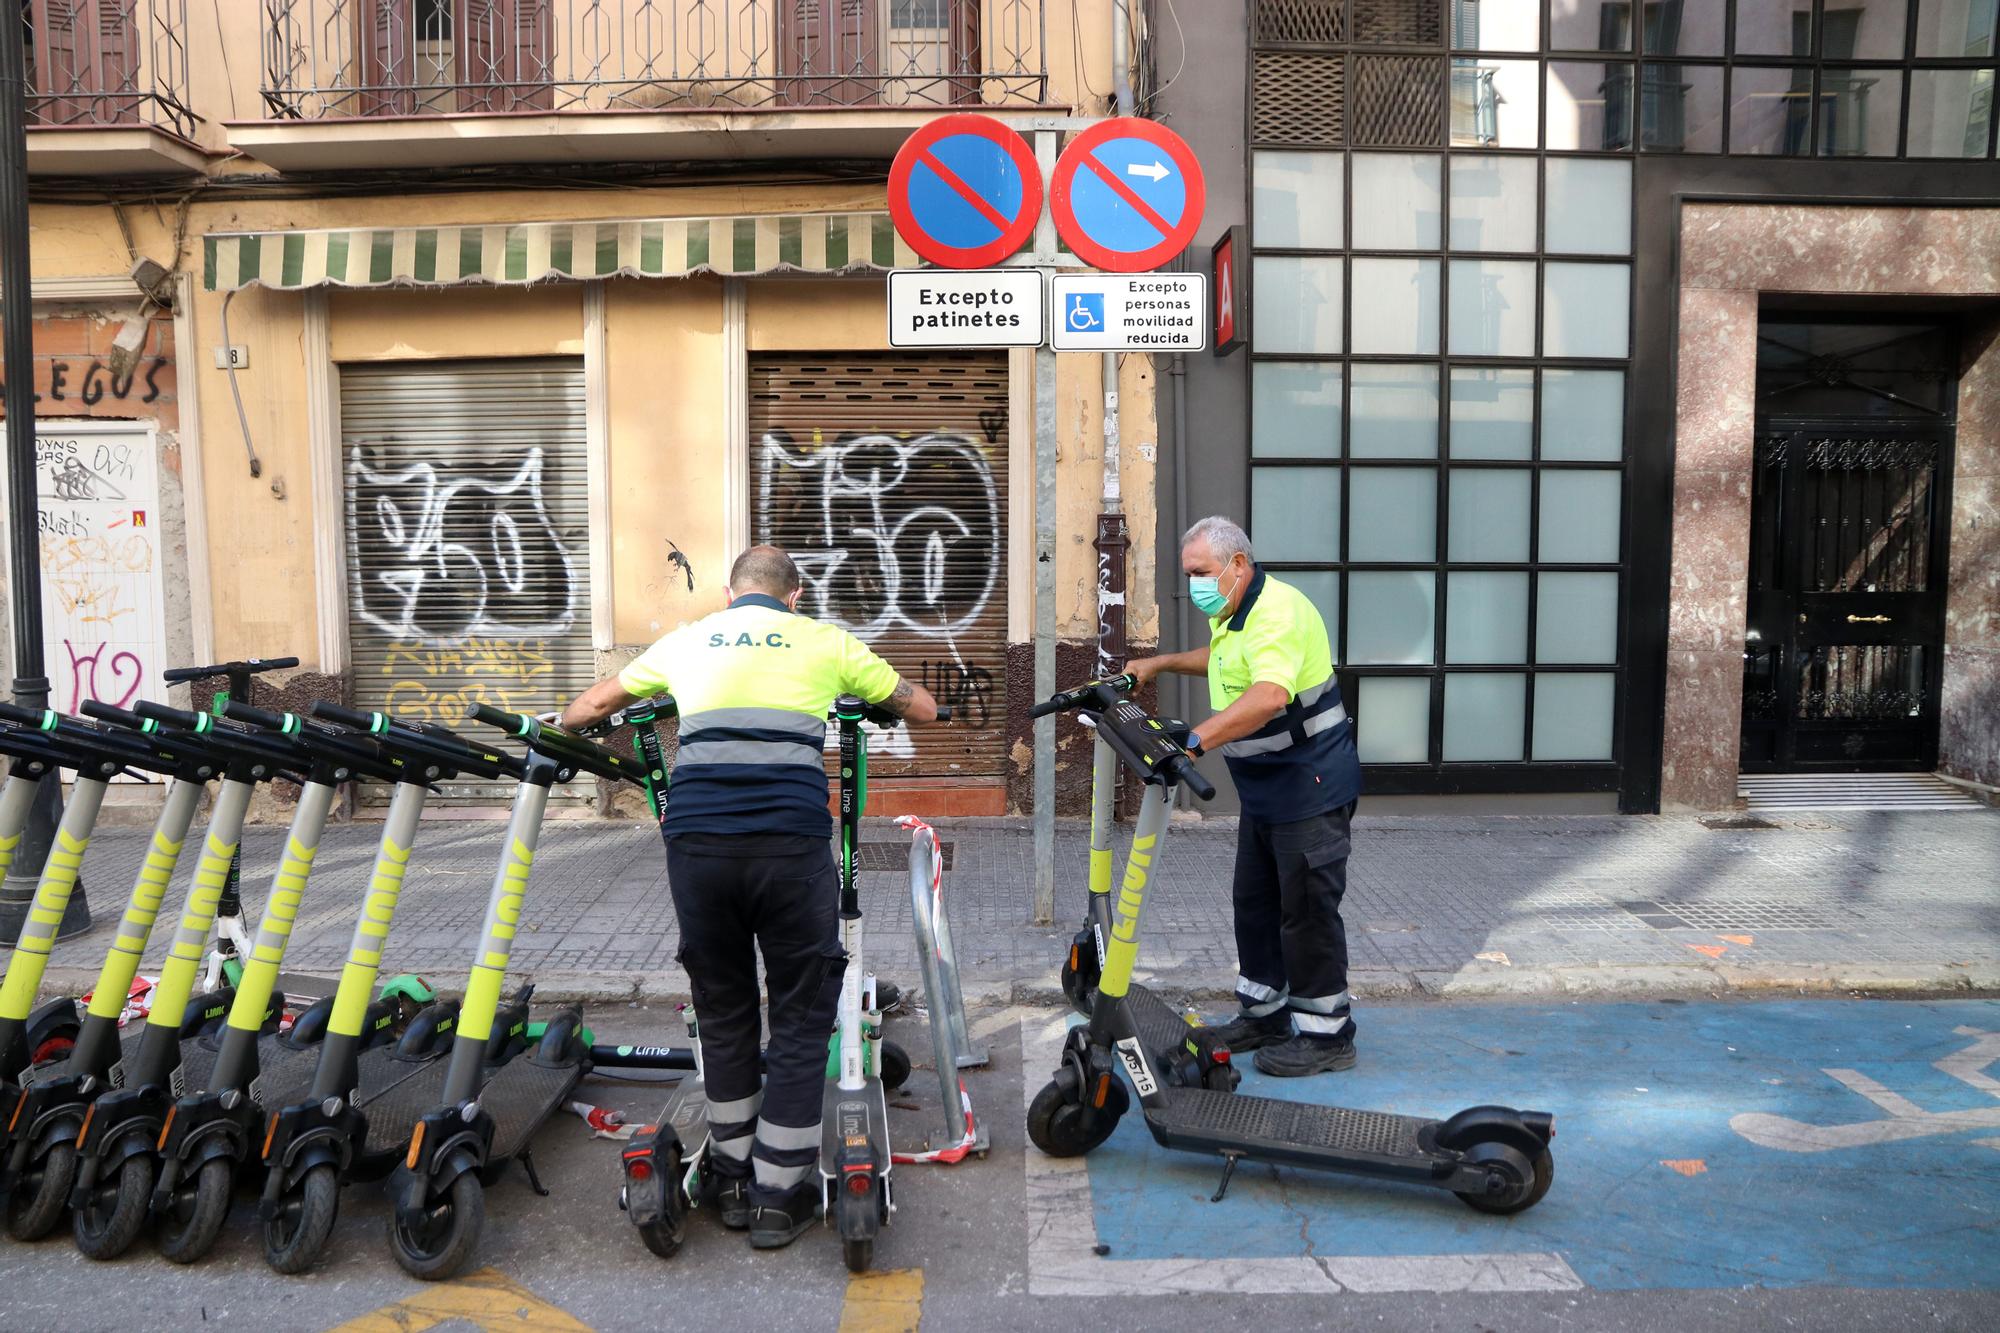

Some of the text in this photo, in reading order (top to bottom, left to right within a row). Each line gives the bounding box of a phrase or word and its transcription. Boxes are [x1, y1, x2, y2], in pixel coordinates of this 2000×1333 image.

[1129, 281, 1188, 296] Excepto
[920, 289, 1014, 307] Excepto
[1125, 299, 1191, 312] personas
[912, 311, 1020, 331] patinetes
[1123, 315, 1194, 327] movilidad
[1127, 332, 1190, 344] reducida
[709, 632, 791, 648] S.A.C.
[635, 1046, 670, 1056] Lime
